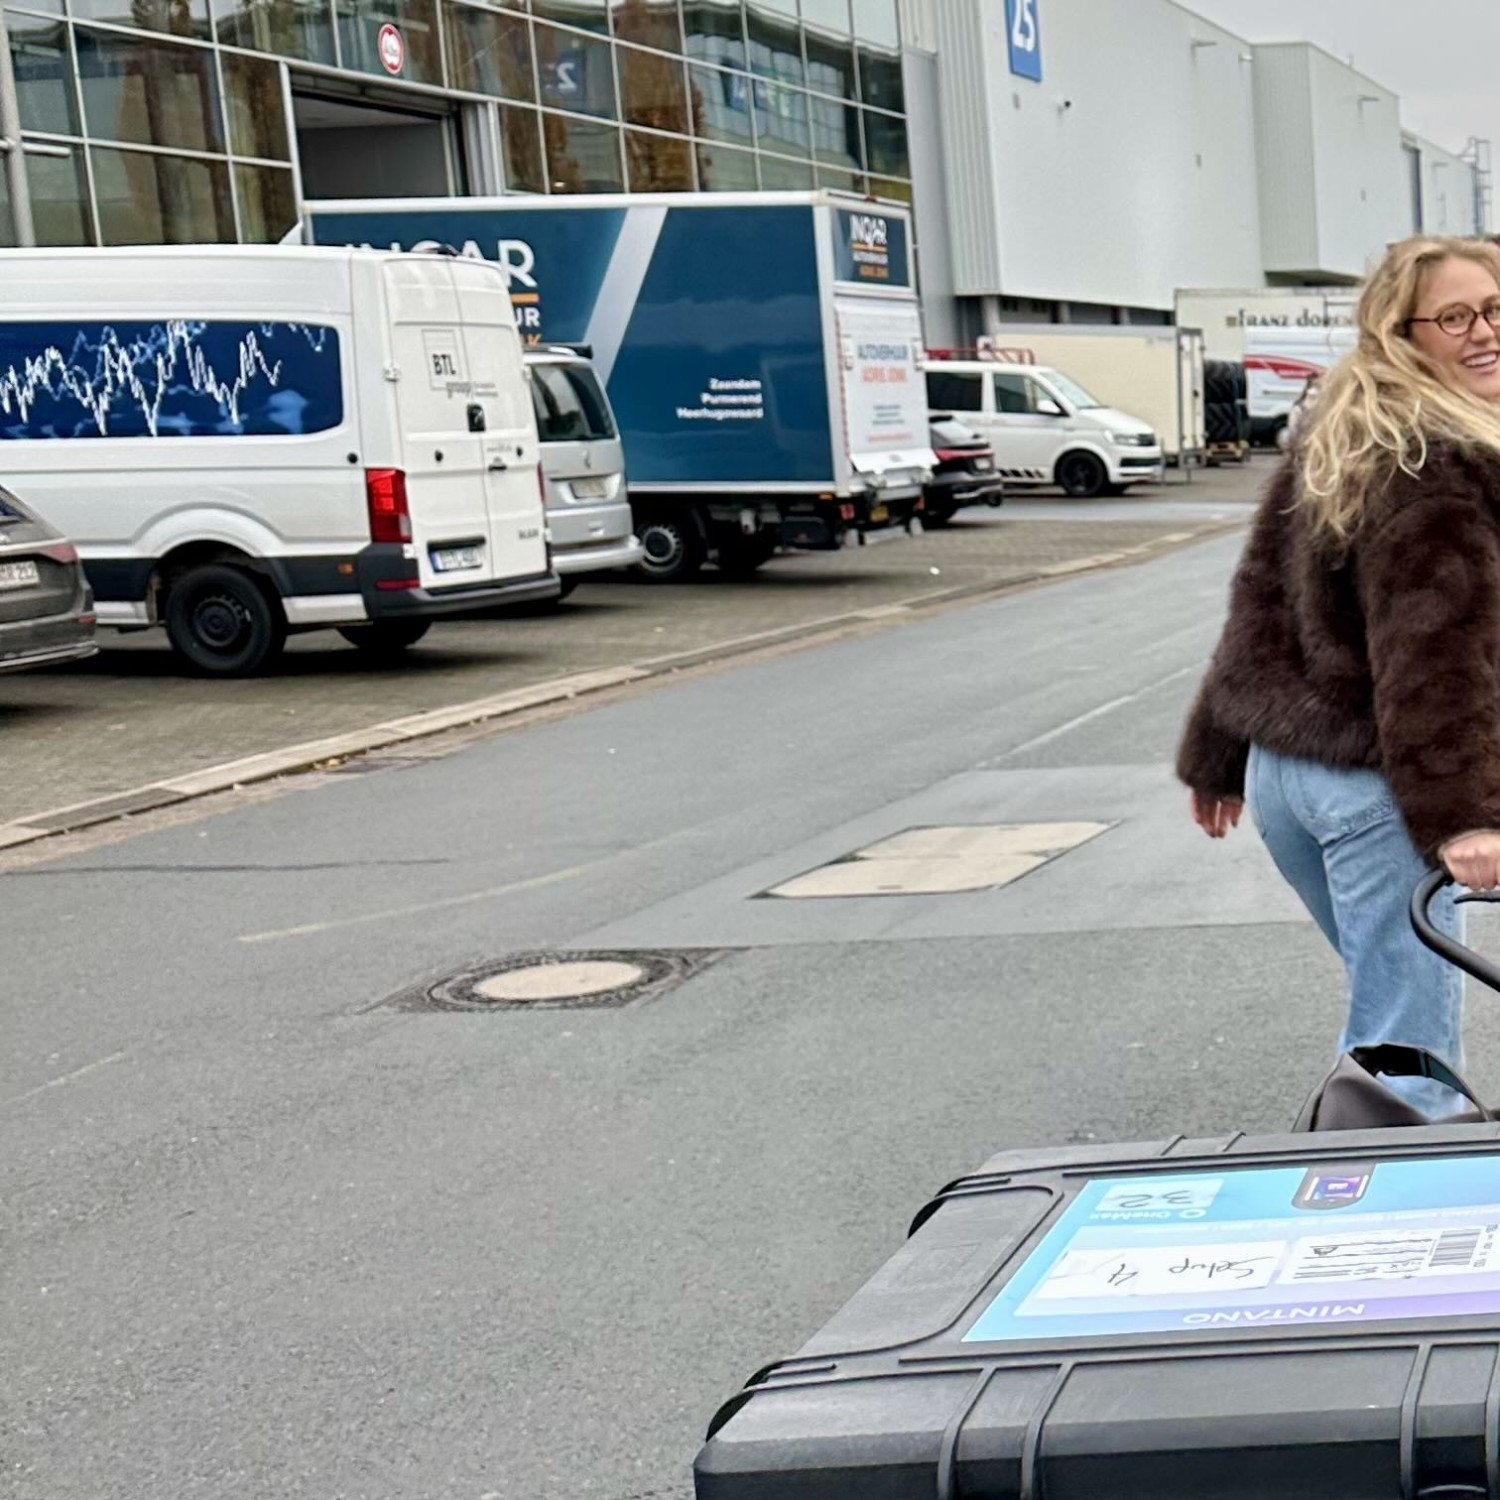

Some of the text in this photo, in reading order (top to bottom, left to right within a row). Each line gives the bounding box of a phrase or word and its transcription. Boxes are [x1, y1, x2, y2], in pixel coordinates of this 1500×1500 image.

[432, 353, 457, 375] BTL
[1168, 1256, 1272, 1281] Setup
[1182, 1304, 1365, 1325] MINTANO
